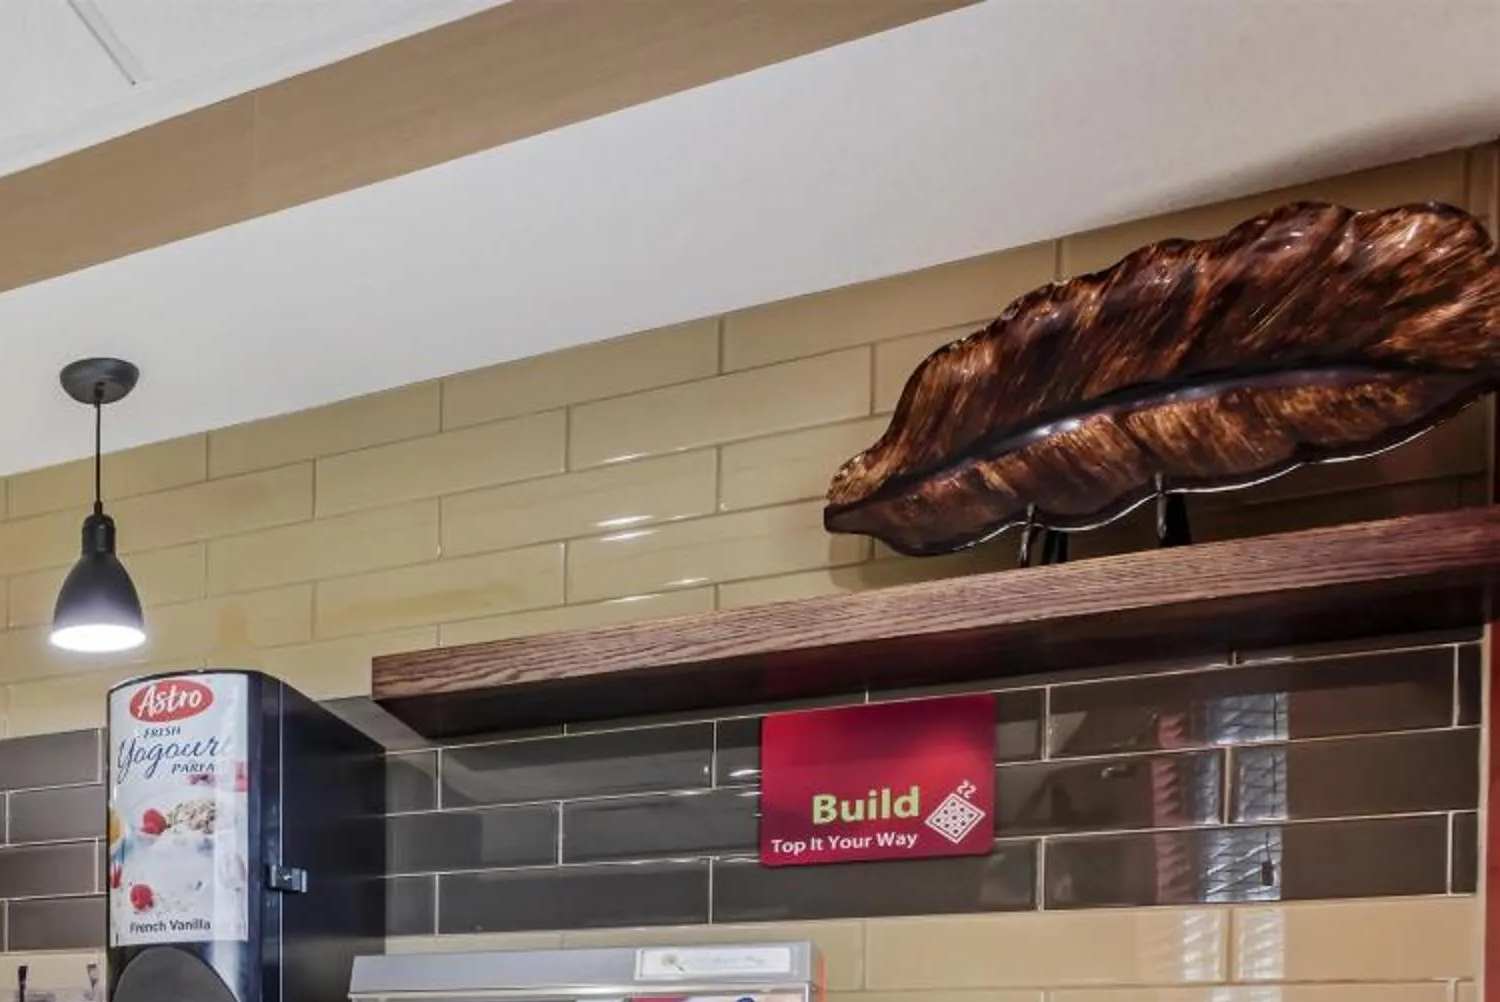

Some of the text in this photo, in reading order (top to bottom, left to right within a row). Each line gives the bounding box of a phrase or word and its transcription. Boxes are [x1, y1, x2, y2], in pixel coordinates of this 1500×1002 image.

[137, 685, 202, 718] Astro
[143, 726, 181, 738] FRESH
[171, 762, 216, 774] PARFA
[812, 785, 920, 825] Build
[771, 832, 918, 856] Top It Your Way
[130, 918, 211, 933] French Vanilla
